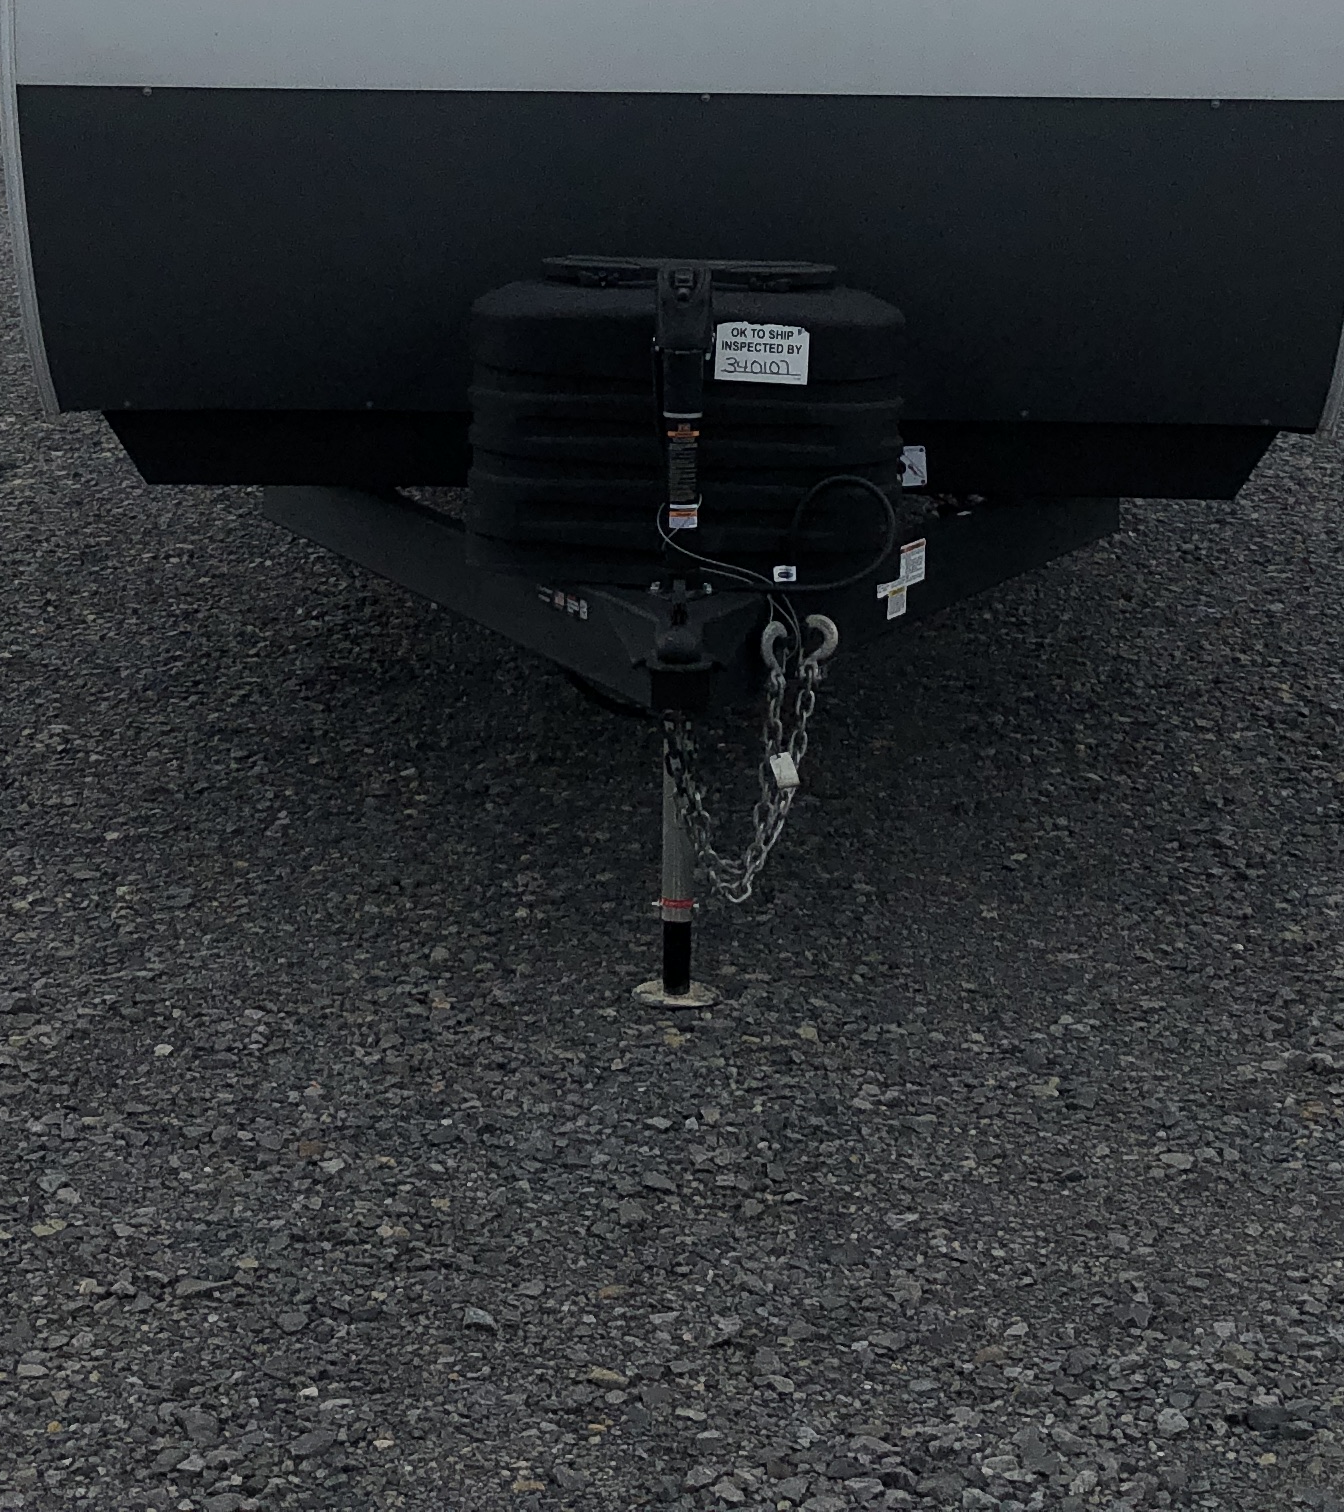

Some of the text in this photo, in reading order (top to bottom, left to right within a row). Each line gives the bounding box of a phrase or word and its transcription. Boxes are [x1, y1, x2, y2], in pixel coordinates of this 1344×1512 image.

[731, 327, 794, 340] OK TO SHIP
[721, 340, 802, 355] INSPECTED BY
